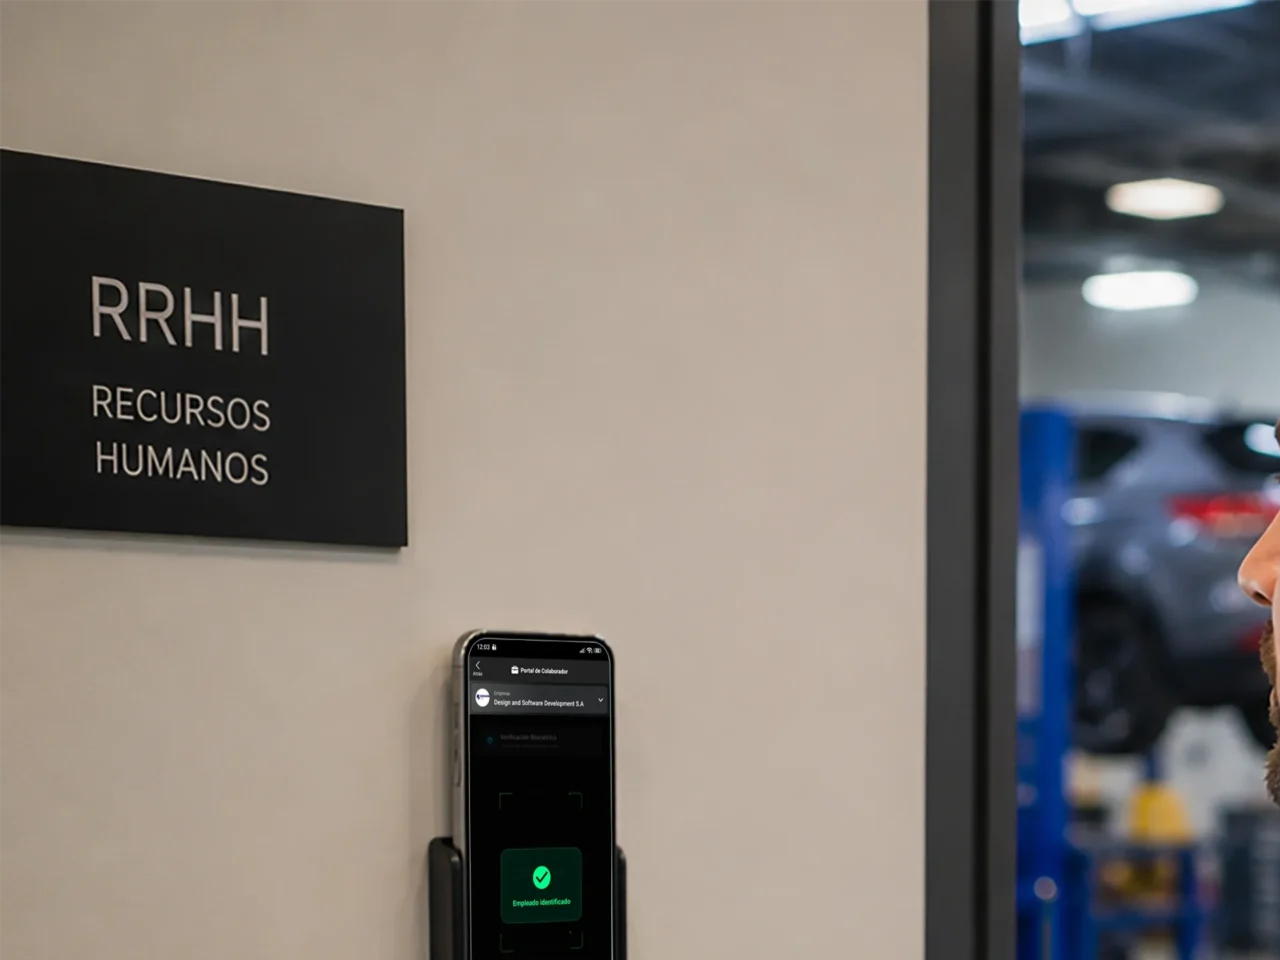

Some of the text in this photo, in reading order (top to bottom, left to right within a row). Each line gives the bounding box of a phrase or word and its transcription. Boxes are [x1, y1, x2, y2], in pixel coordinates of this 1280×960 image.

[92, 276, 267, 355] RRHH
[93, 385, 270, 431] RECURSOS
[97, 442, 268, 485] HUMANOS
[494, 699, 511, 707] Design
[522, 699, 543, 707] Software
[544, 700, 574, 708] Development
[512, 897, 571, 908] Empleado identificado
